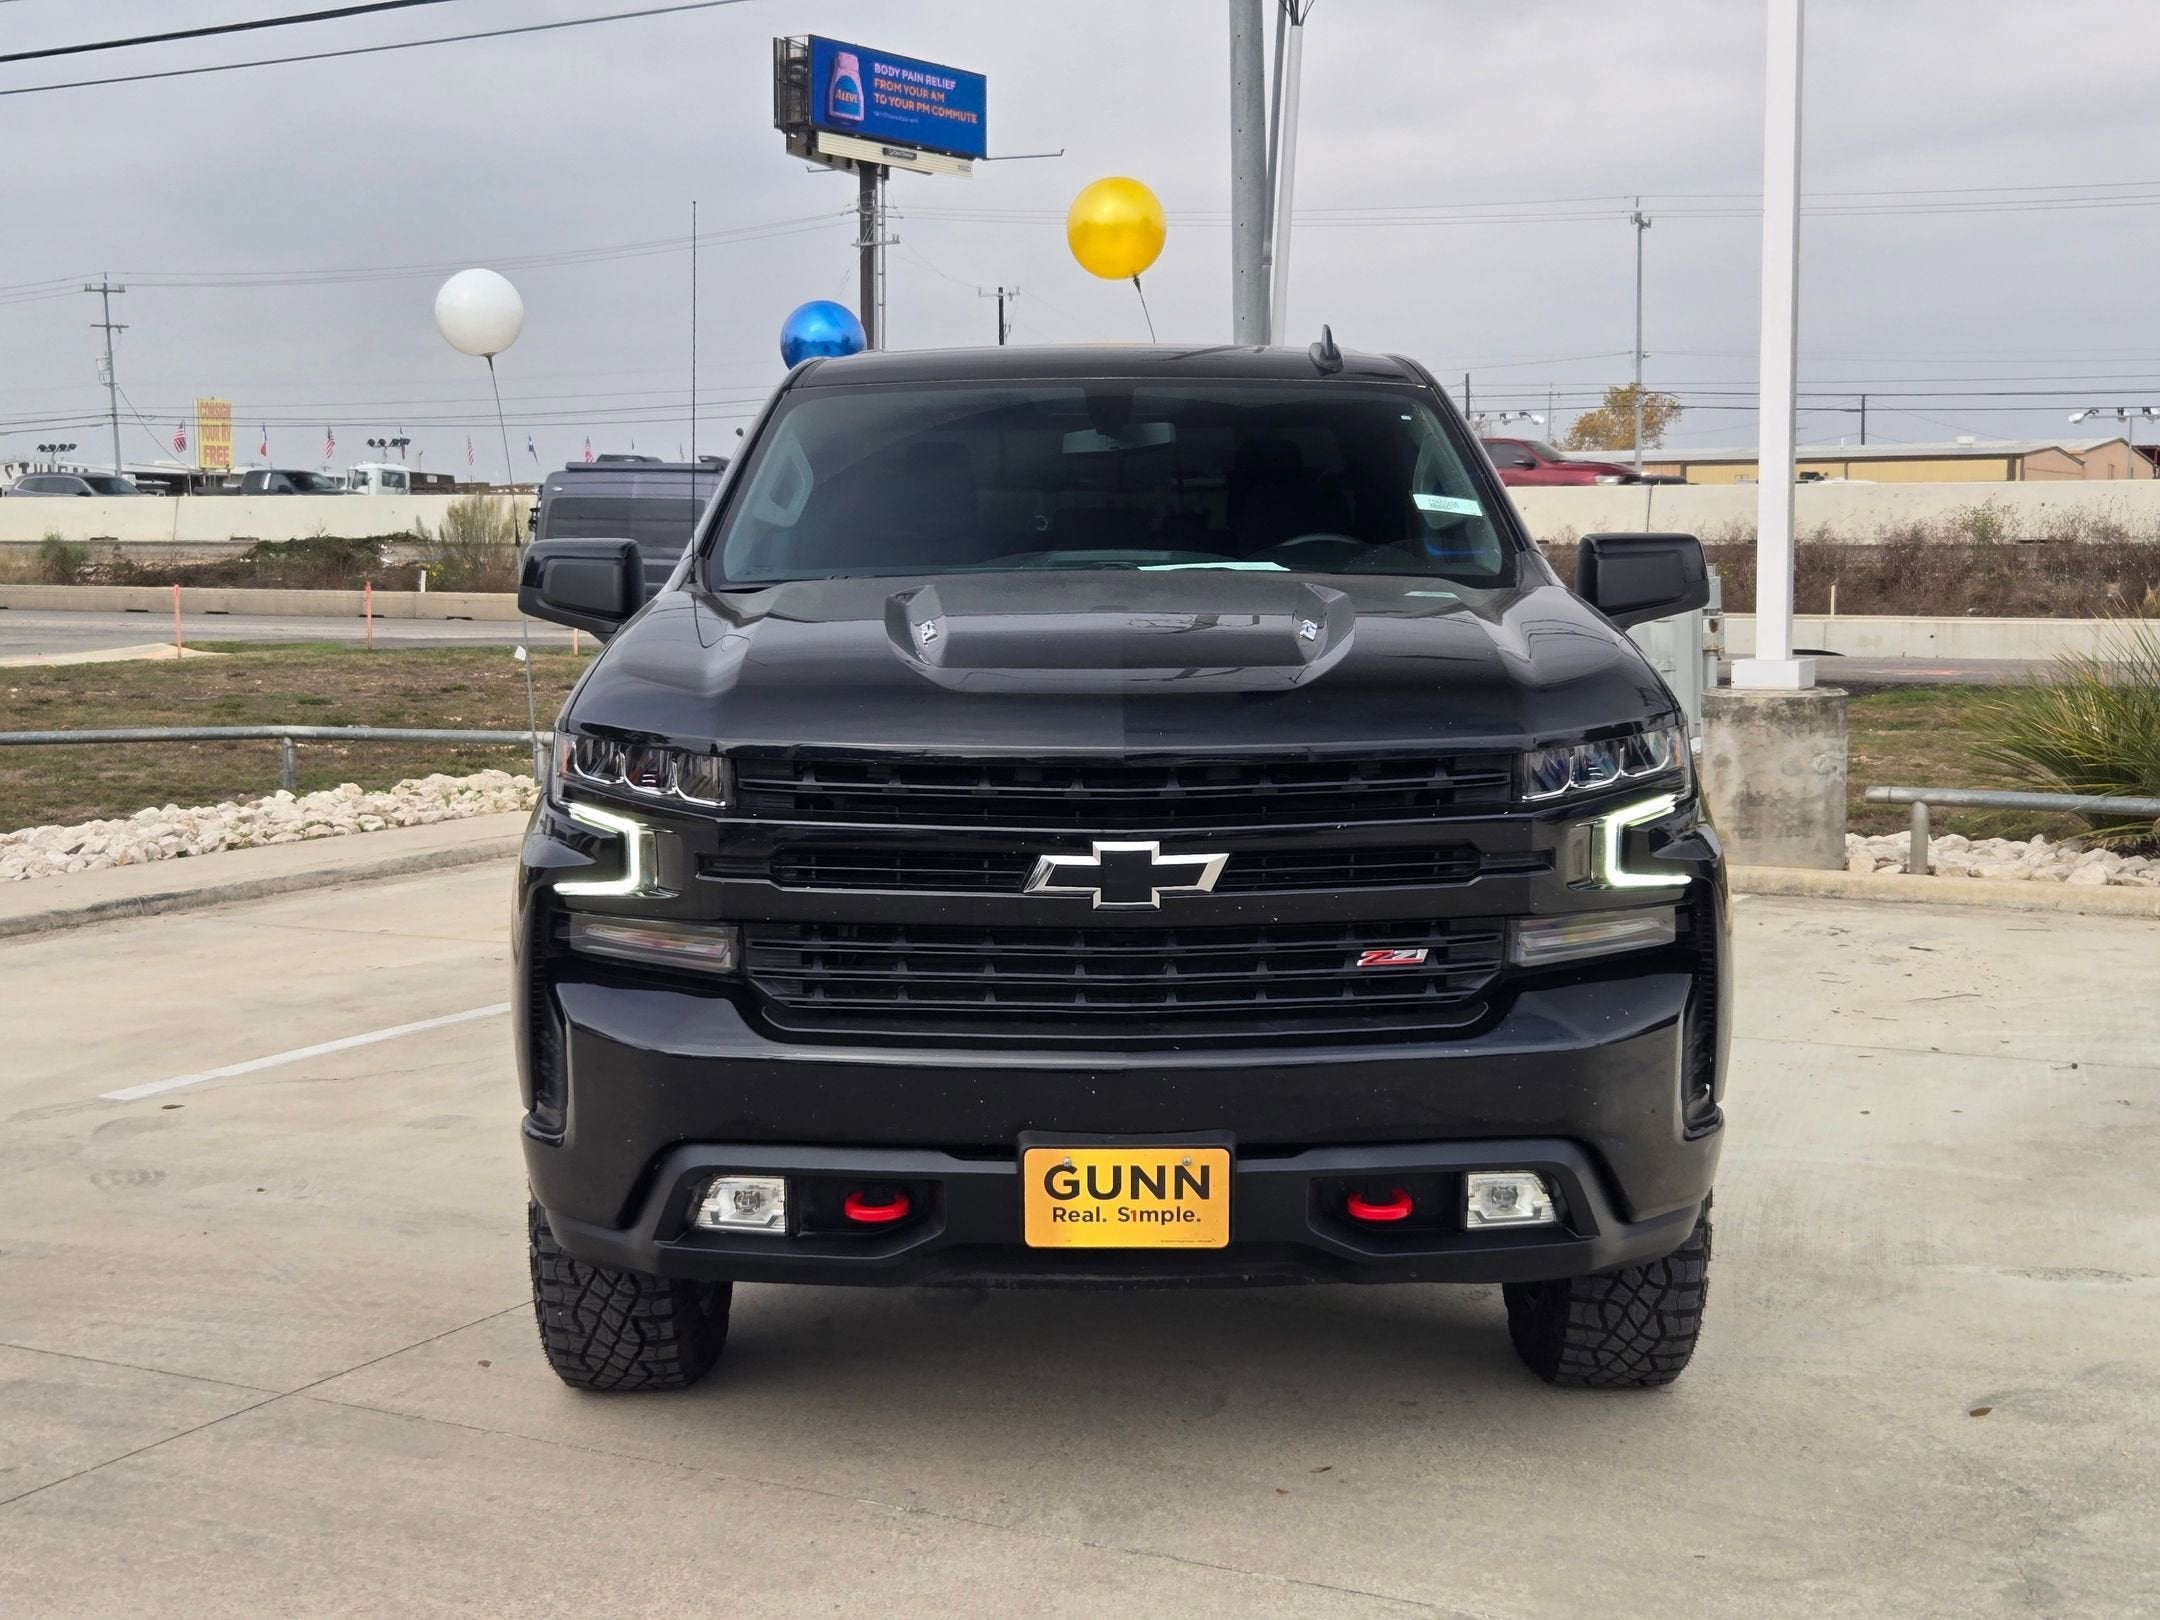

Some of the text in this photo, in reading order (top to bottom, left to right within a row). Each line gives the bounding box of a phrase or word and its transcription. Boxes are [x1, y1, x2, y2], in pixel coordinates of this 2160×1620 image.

[874, 63, 956, 90] BODY PAIN RELIEF
[874, 79, 945, 102] FROM YOUR AM
[874, 93, 887, 104] TO
[888, 97, 914, 110] YOUR
[916, 103, 930, 113] PM
[931, 107, 977, 123] COMMUTE
[200, 401, 232, 421] CONSIGN
[201, 424, 231, 442] YOUR RV
[204, 445, 230, 465] FREE
[1044, 1164, 1210, 1200] GUNN
[1053, 1206, 1107, 1223] Real.
